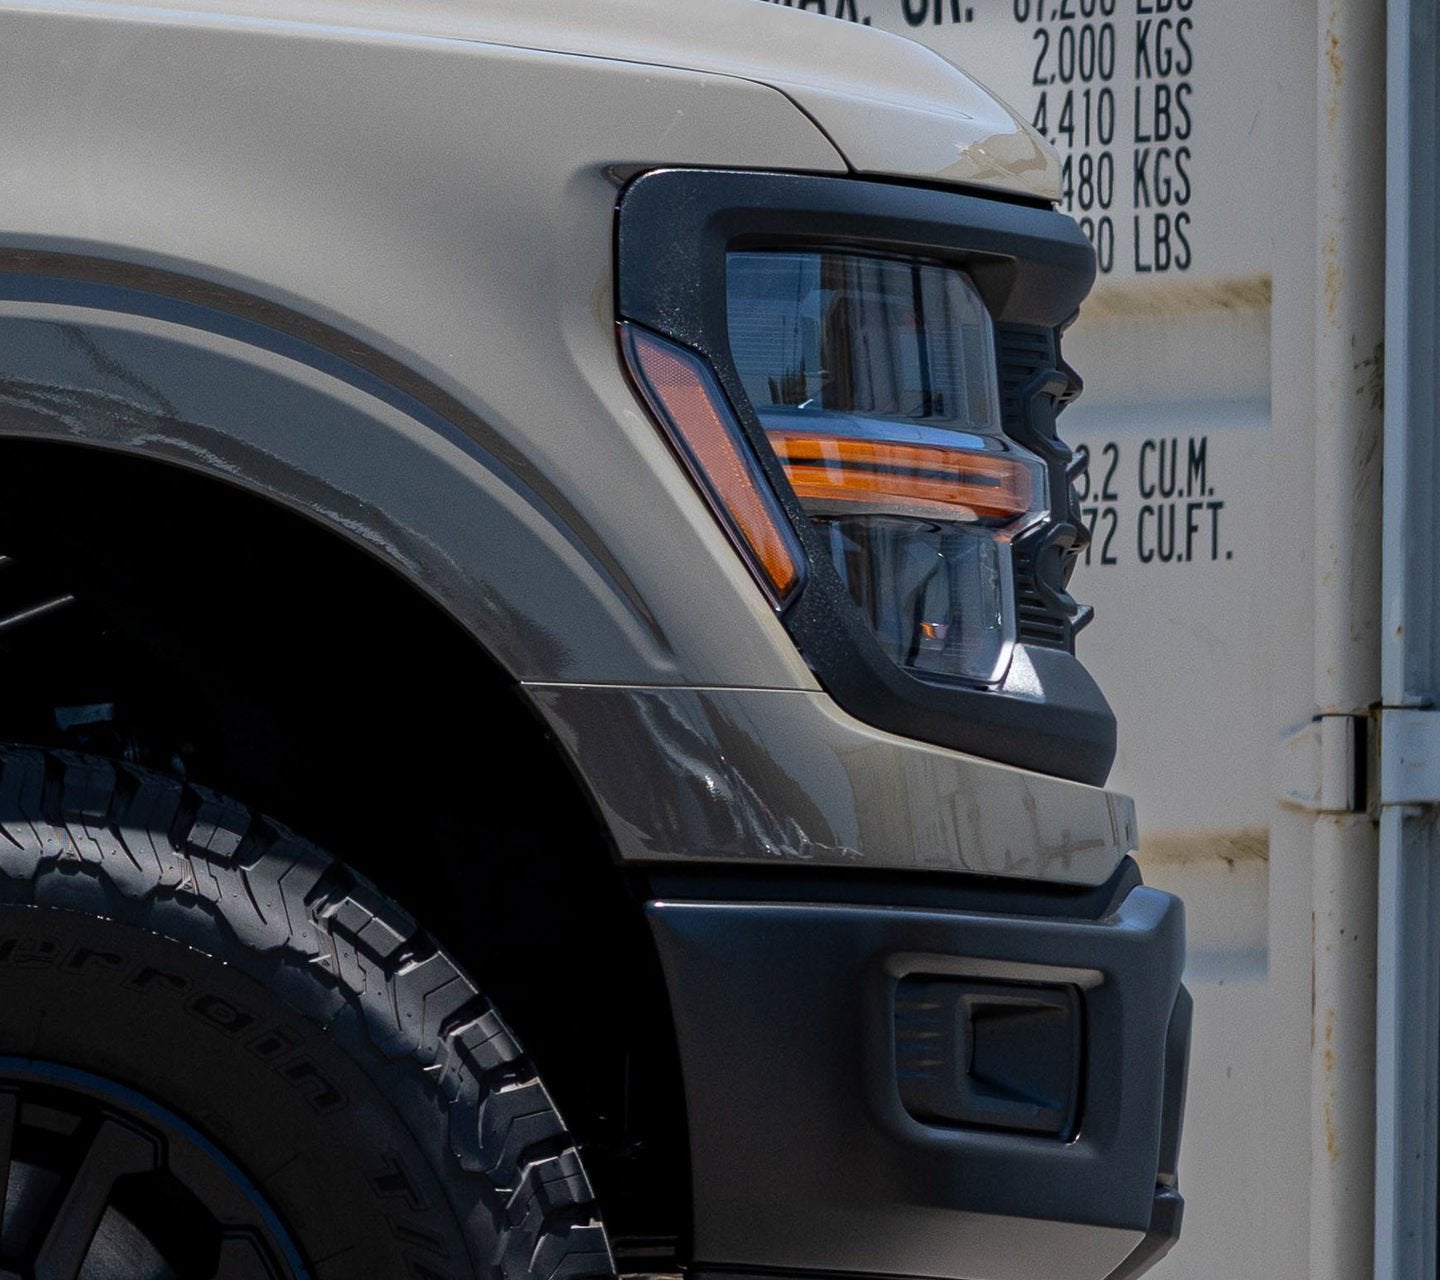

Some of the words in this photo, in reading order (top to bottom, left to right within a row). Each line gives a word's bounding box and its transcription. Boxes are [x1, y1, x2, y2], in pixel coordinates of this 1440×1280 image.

[1032, 22, 1116, 87] 2,000
[1134, 17, 1194, 80] KGS
[1133, 83, 1193, 145] LBS
[1133, 147, 1192, 209] KGS
[1134, 211, 1192, 274] LBS
[1138, 436, 1214, 499] CU.M.
[1136, 502, 1233, 564] CU.FT.
